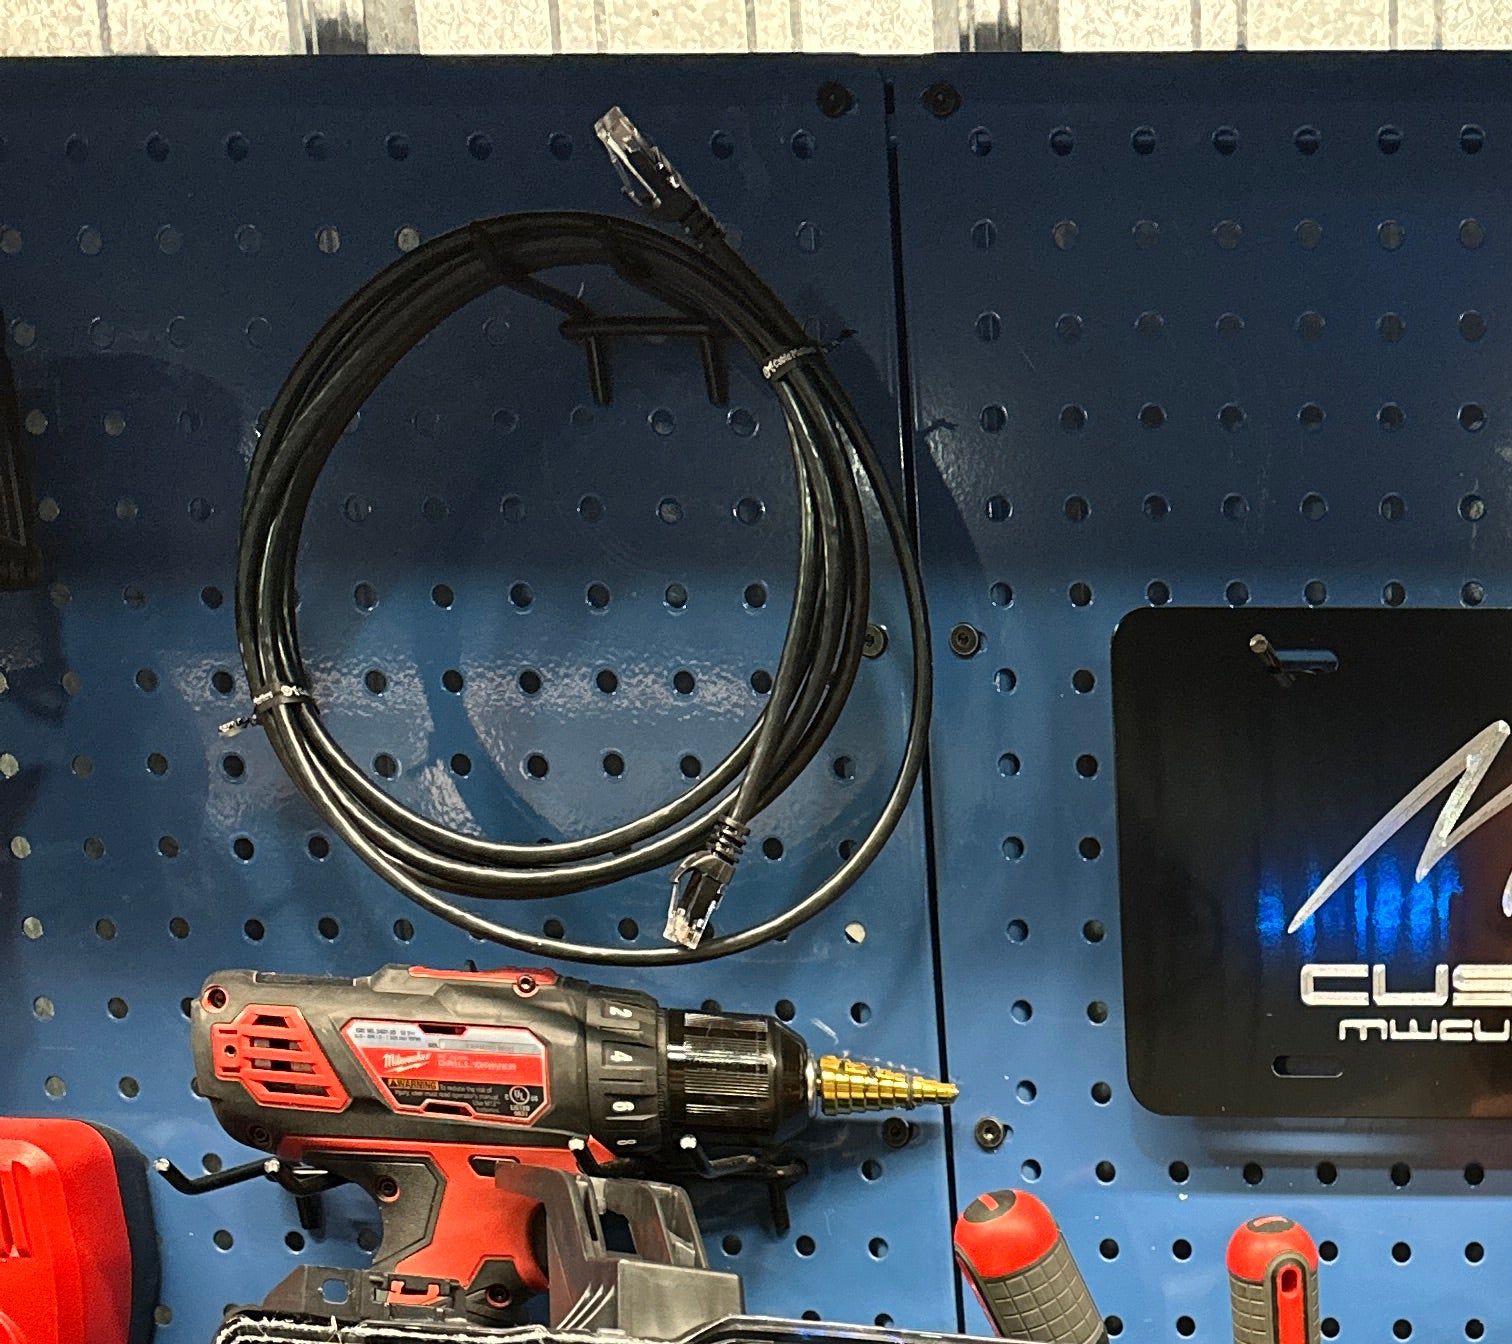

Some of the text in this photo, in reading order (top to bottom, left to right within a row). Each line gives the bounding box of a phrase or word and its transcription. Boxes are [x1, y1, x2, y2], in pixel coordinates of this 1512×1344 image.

[609, 1006, 633, 1018] 2
[610, 1050, 633, 1062] 4
[514, 1090, 525, 1101] UL
[612, 1101, 635, 1112] 6
